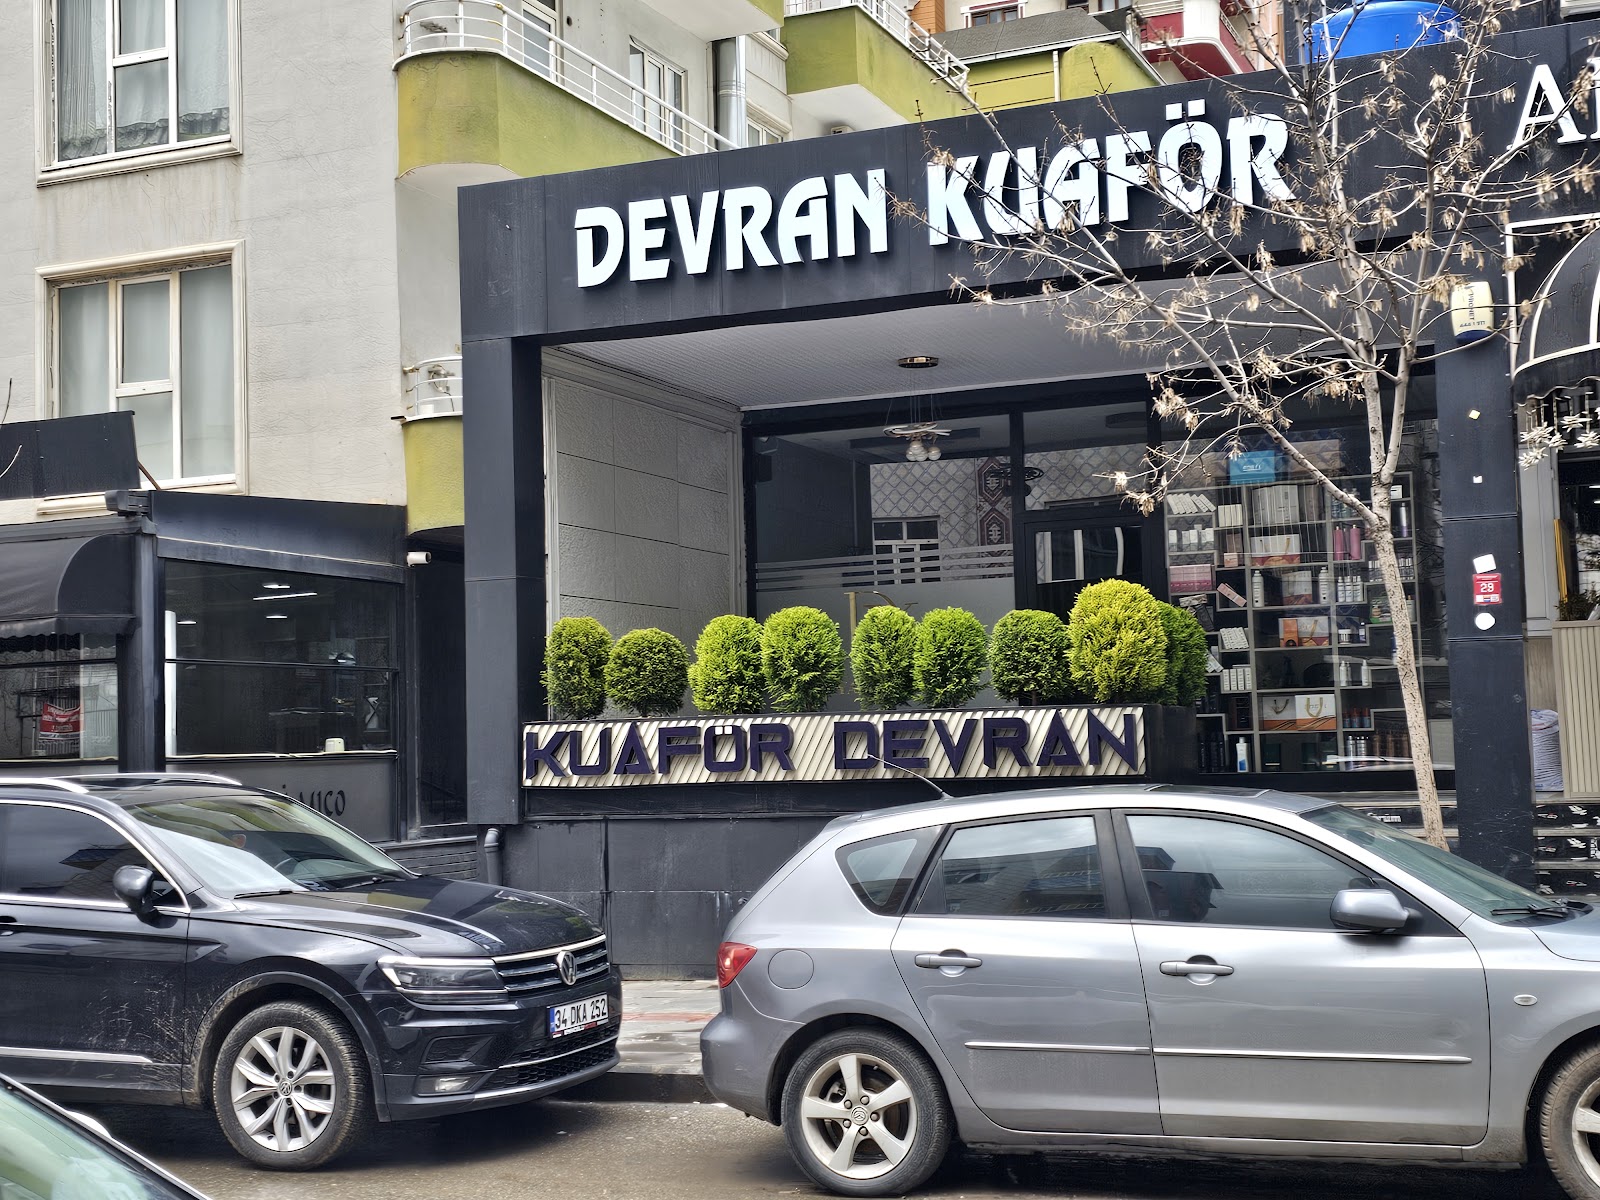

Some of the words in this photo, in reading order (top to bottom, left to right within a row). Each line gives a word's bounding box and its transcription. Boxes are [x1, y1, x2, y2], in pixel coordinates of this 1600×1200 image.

[574, 168, 888, 288] DEVRAN
[927, 99, 1297, 246] KUAFÖR
[1480, 582, 1495, 593] 29
[526, 721, 796, 779] KUAFÖR
[833, 708, 1138, 776] DEVRAN
[555, 1008, 568, 1029] 34
[570, 1003, 588, 1026] DKA
[590, 998, 607, 1020] 252
